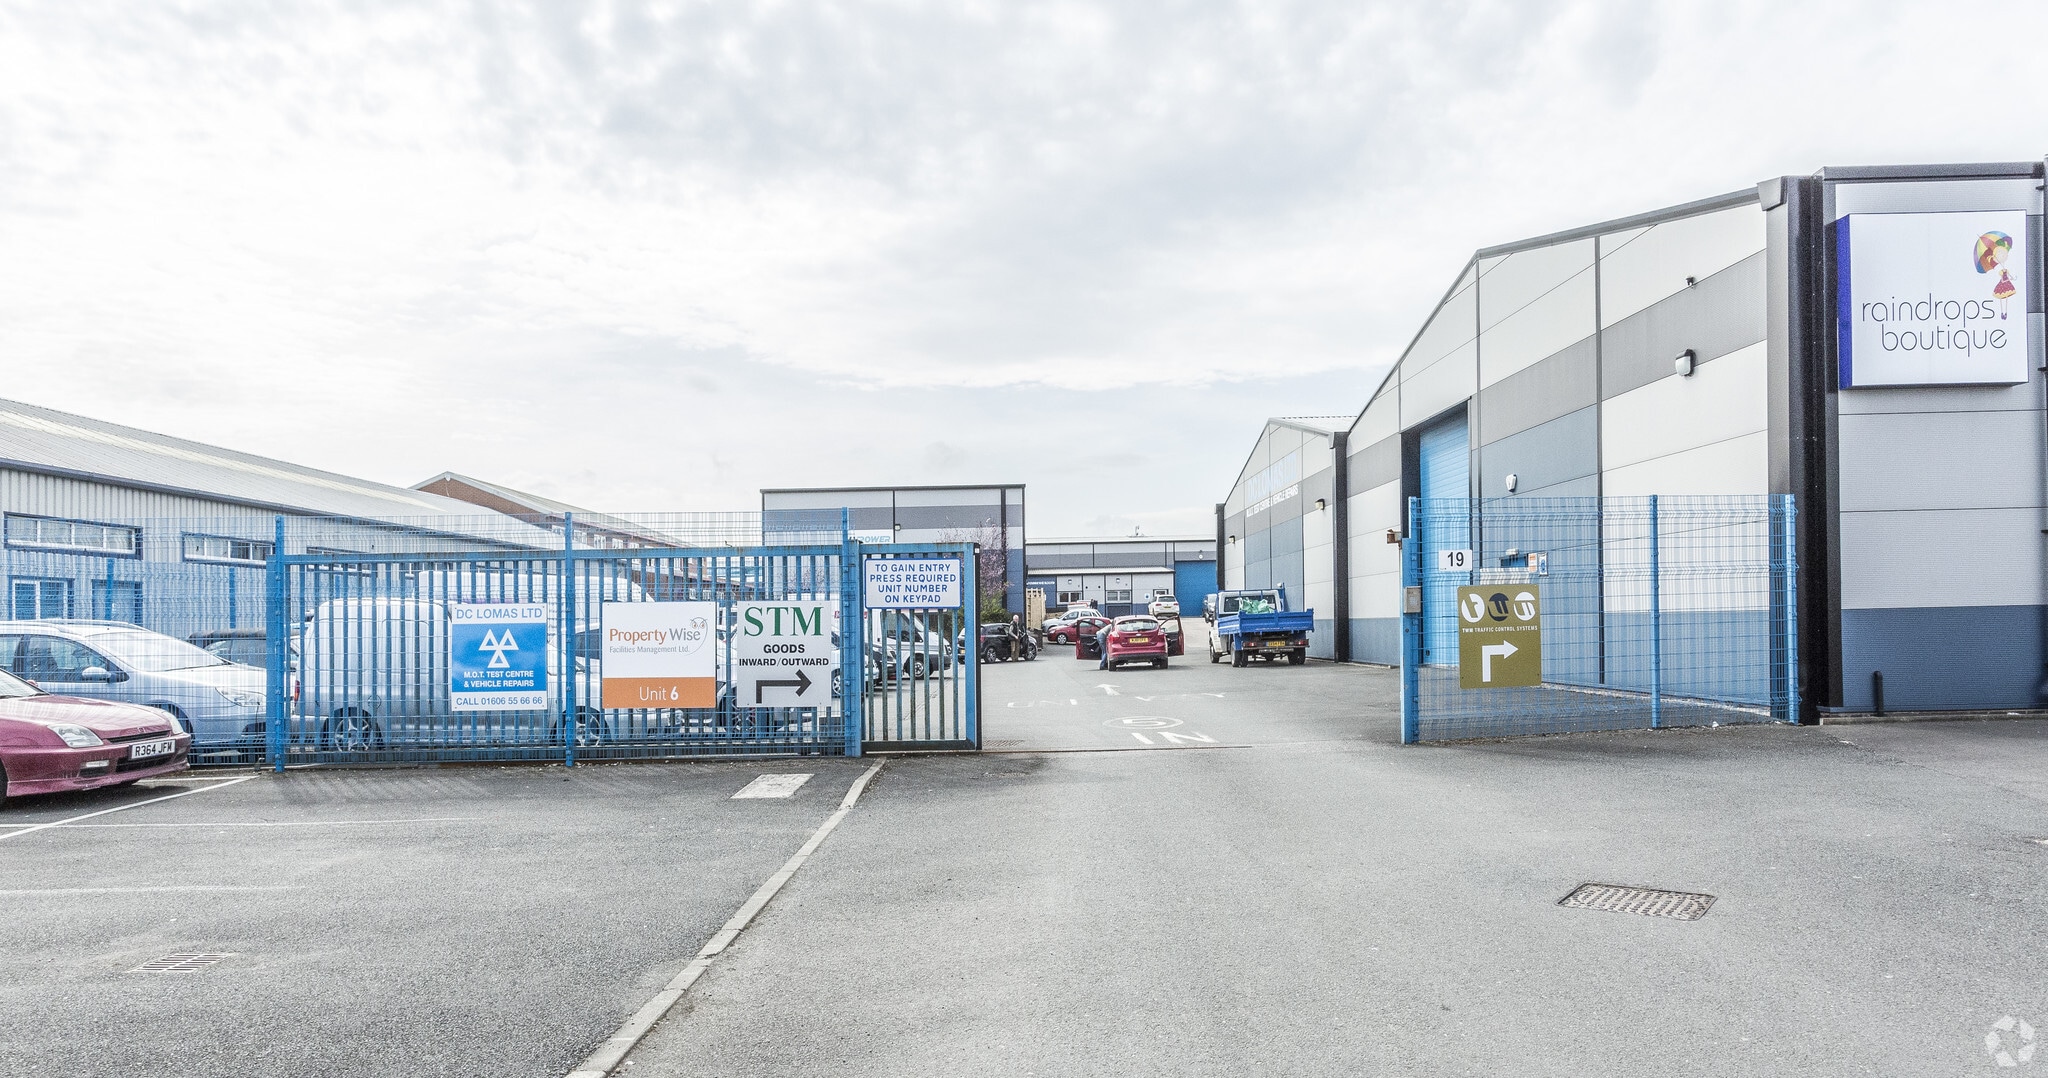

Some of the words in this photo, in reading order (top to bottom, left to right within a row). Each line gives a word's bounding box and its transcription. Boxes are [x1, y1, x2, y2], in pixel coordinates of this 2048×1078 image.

[1862, 292, 1996, 328] raindrops
[1881, 323, 2007, 358] boutique
[1447, 551, 1465, 567] 19
[875, 563, 888, 572] TO
[891, 563, 915, 572] GAIN
[919, 563, 951, 572] ENTRY
[869, 574, 902, 582] PRESS
[905, 574, 957, 582] REQUIRED
[878, 584, 902, 593] UNIT
[905, 584, 948, 593] NUMBER
[884, 594, 900, 603] ON
[903, 594, 941, 603] KEYPAD
[456, 608, 473, 619] DC
[476, 608, 518, 619] LOMAS
[521, 607, 543, 618] LTD
[744, 606, 824, 637] STM
[609, 628, 667, 645] Property
[669, 627, 701, 641] Wise
[637, 646, 677, 654] Management
[678, 645, 690, 653] Ltd.
[763, 644, 805, 654] GOODS
[739, 658, 829, 667] INWARD/OUTWARD
[505, 670, 534, 678] CENTRE
[470, 680, 502, 688] VEHICLE
[639, 686, 667, 701] Unit
[670, 686, 679, 701] 6
[456, 697, 479, 706] CALL
[481, 697, 506, 705] 01606
[508, 697, 518, 705] 55
[520, 696, 531, 705] 66
[532, 696, 543, 704] 66
[1131, 731, 1220, 745] IN
[135, 744, 157, 757] R364
